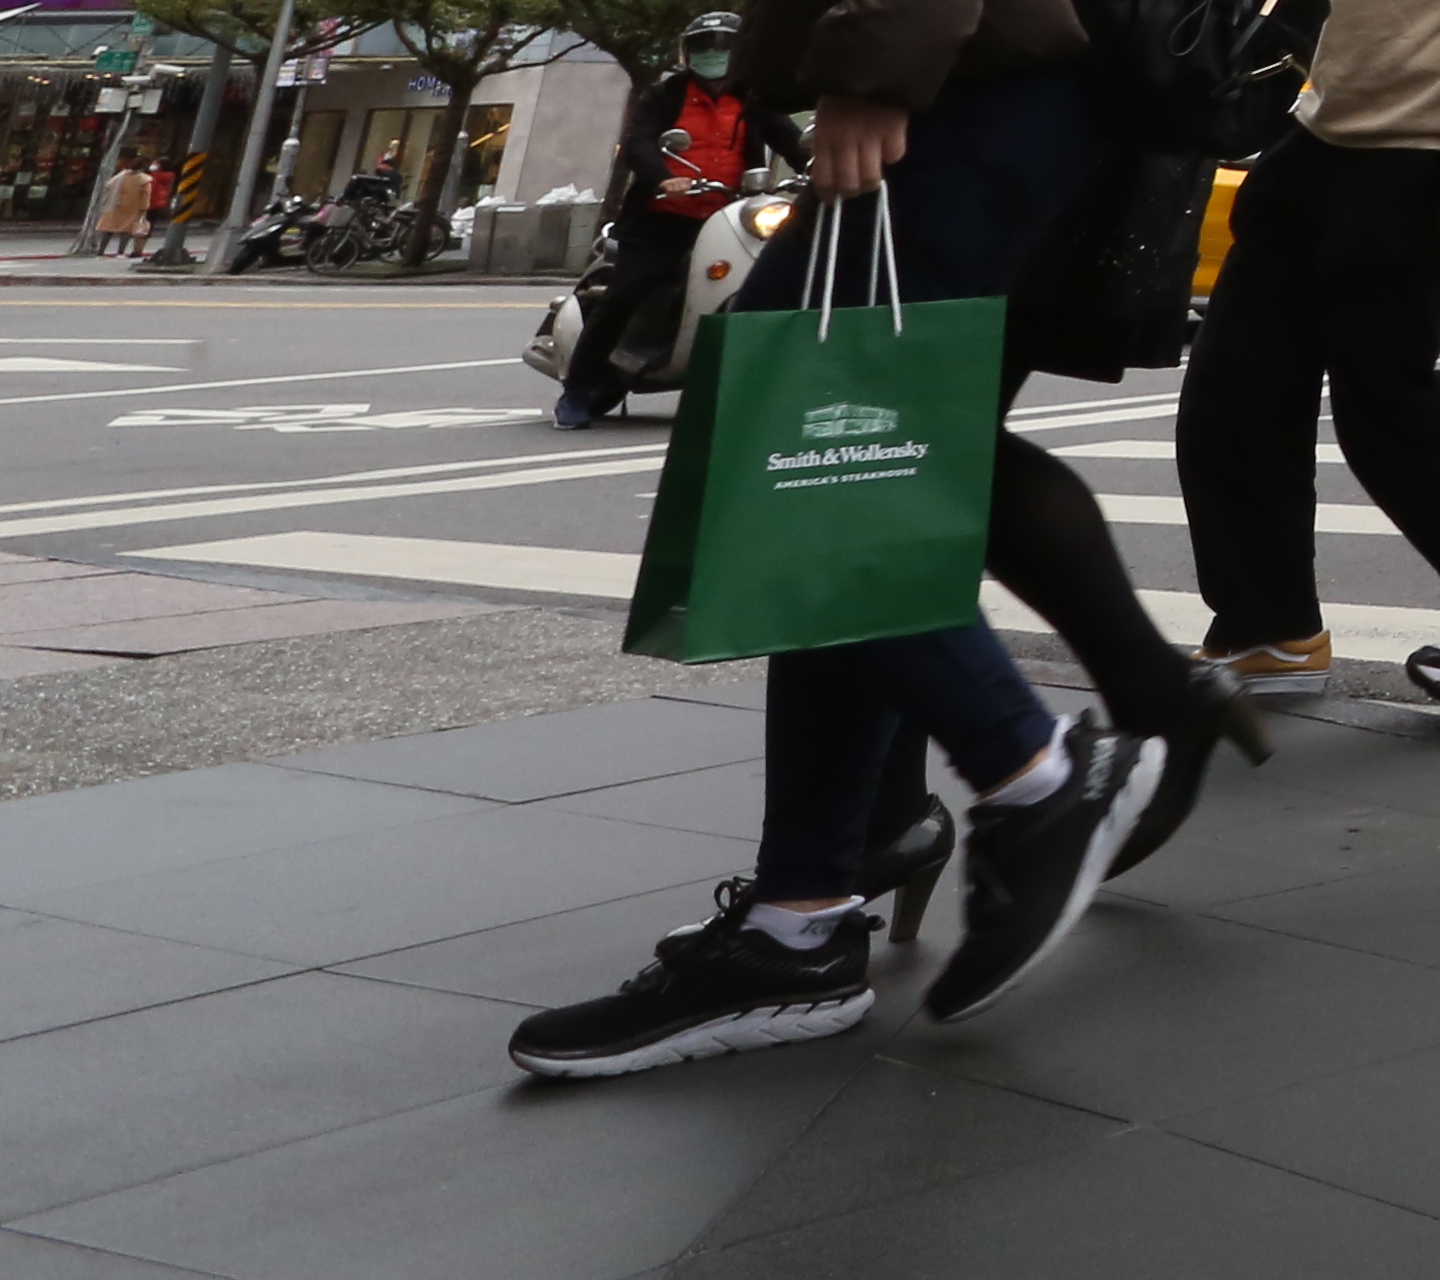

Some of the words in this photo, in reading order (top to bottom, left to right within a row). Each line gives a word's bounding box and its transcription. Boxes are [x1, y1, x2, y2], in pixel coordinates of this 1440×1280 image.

[766, 450, 822, 472] Smith
[822, 447, 841, 467] &
[840, 439, 930, 465] Wollensky
[773, 474, 839, 490] AMERICA'S
[841, 467, 918, 484] STEAKHOUSE
